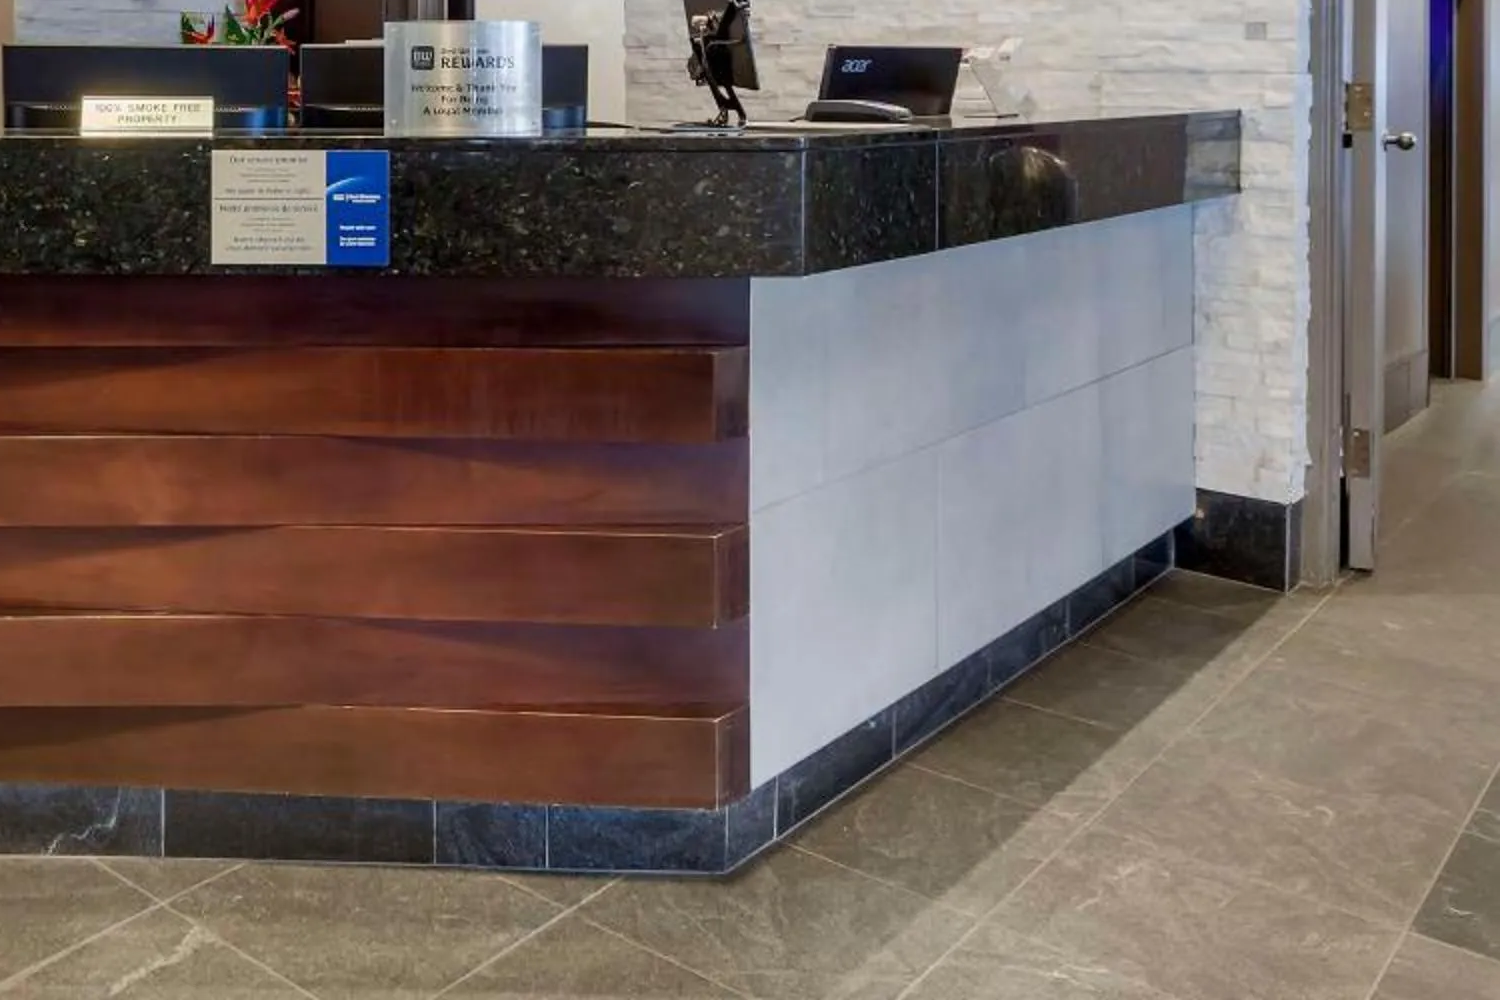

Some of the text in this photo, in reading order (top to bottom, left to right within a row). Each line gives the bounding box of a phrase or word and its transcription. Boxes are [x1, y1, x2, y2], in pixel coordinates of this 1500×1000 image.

[441, 55, 515, 69] REWARDS
[841, 59, 872, 73] acer
[127, 103, 167, 113] SMOKE
[173, 103, 201, 113] FREE
[423, 107, 431, 116] A
[117, 114, 178, 124] PROPERTY
